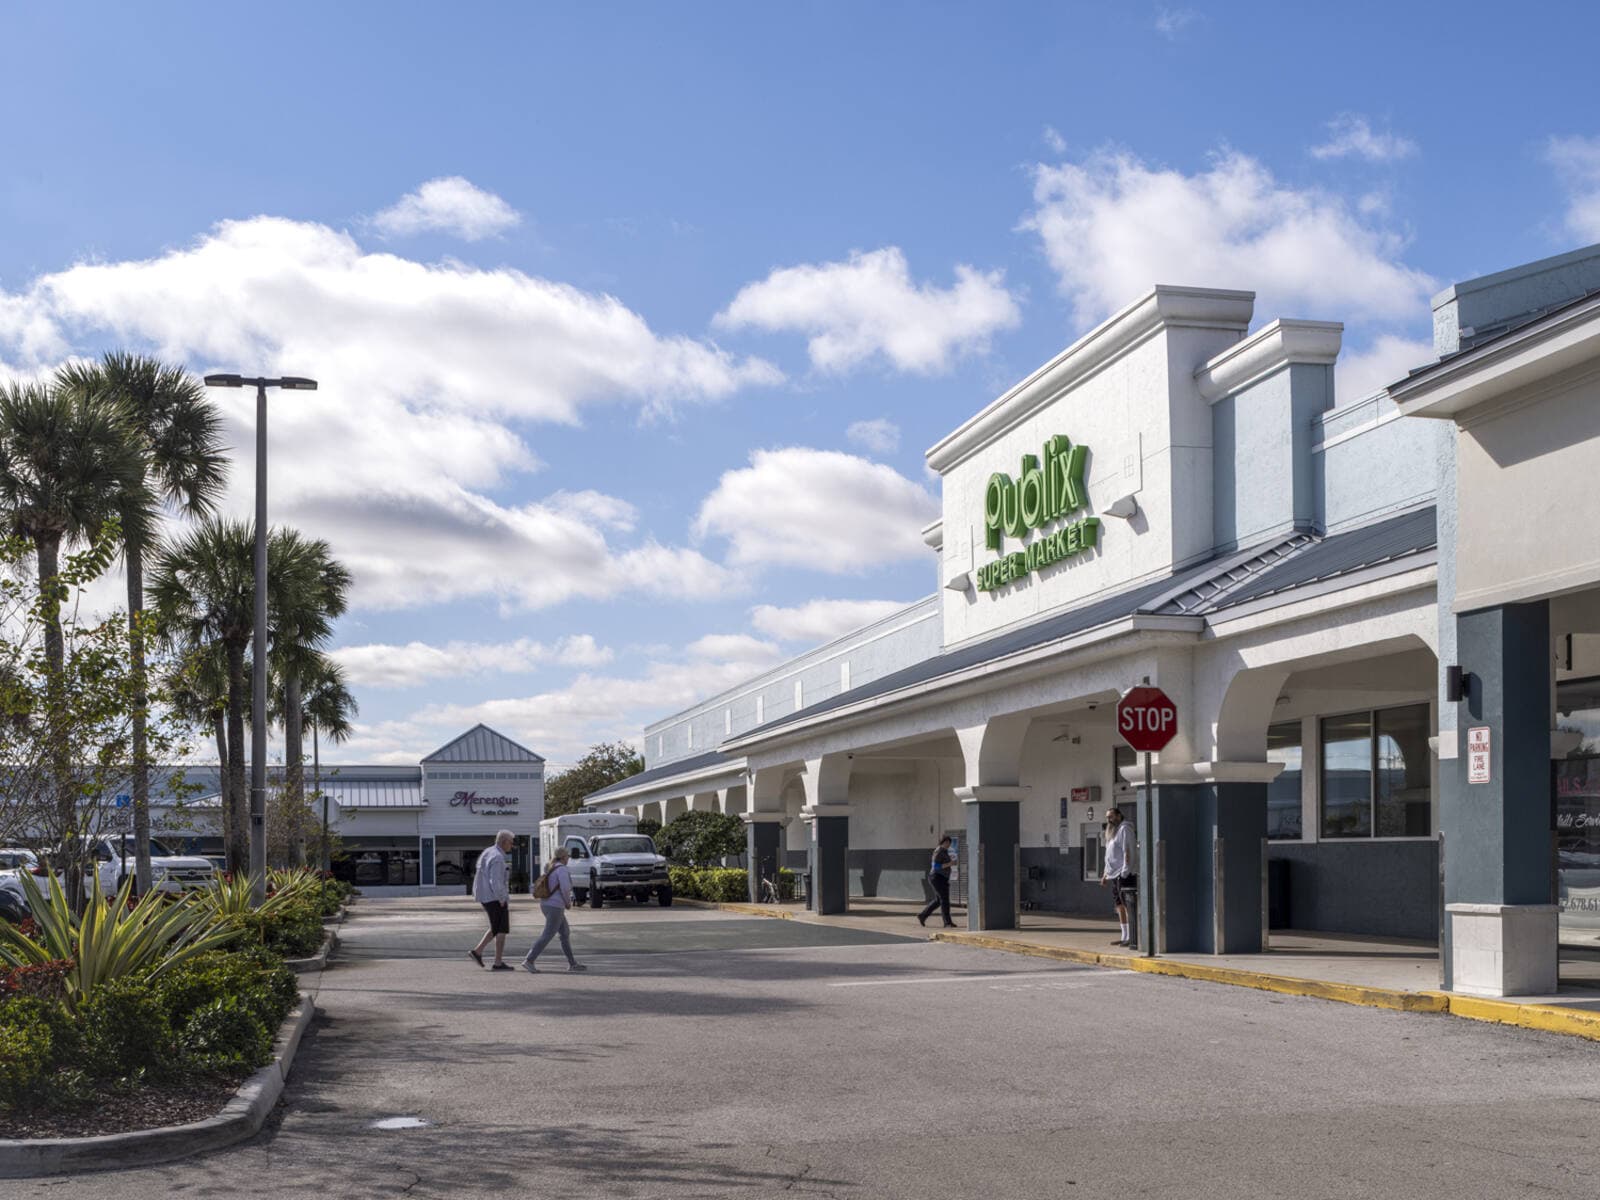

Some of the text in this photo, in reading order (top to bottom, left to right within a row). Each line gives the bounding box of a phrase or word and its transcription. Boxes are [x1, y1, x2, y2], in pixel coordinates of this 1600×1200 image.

[985, 434, 1088, 550] Publix
[977, 517, 1099, 592] SUPER MARKET
[1121, 706, 1174, 731] STOP
[1470, 743, 1489, 752] PARKING
[449, 790, 519, 814] Merengue
